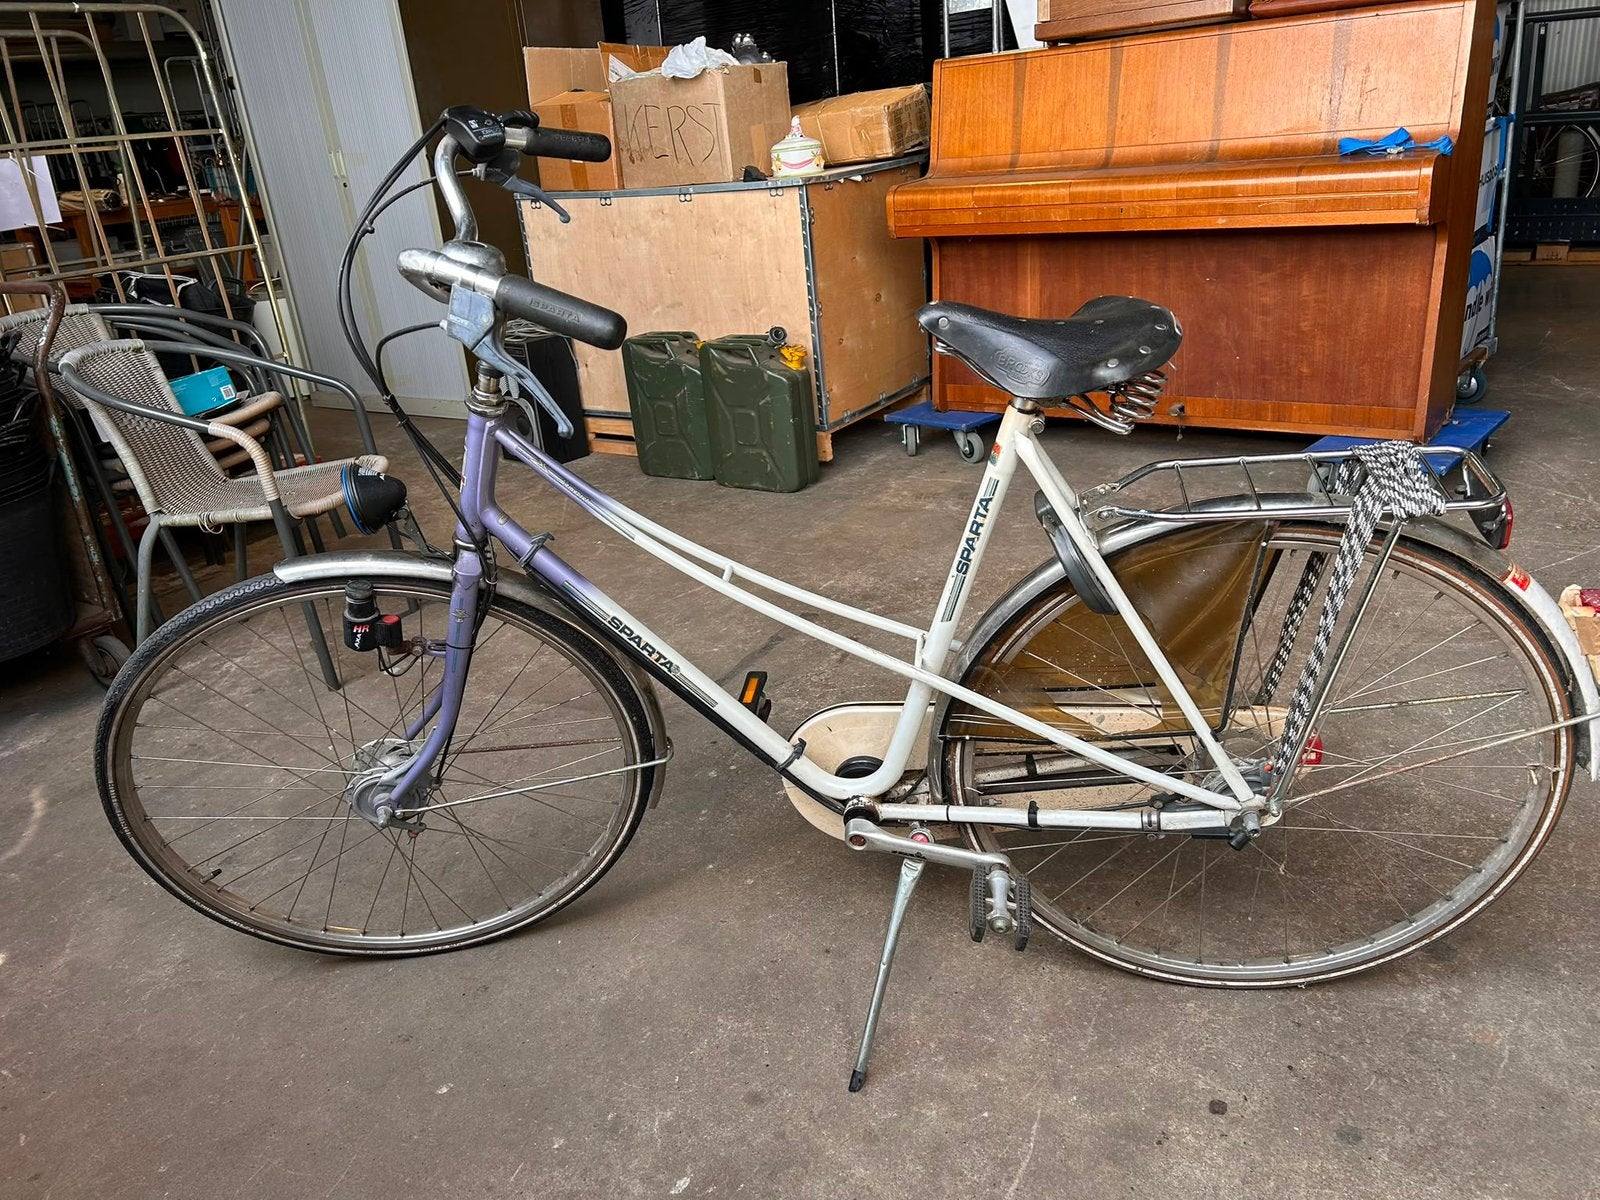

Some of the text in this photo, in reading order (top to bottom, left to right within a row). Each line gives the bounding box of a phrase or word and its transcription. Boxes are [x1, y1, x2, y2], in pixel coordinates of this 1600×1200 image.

[622, 101, 725, 171] KERST
[530, 299, 582, 323] SPARTA
[956, 495, 993, 576] SPARTA
[352, 624, 370, 633] HR
[607, 615, 675, 674] SPARTA
